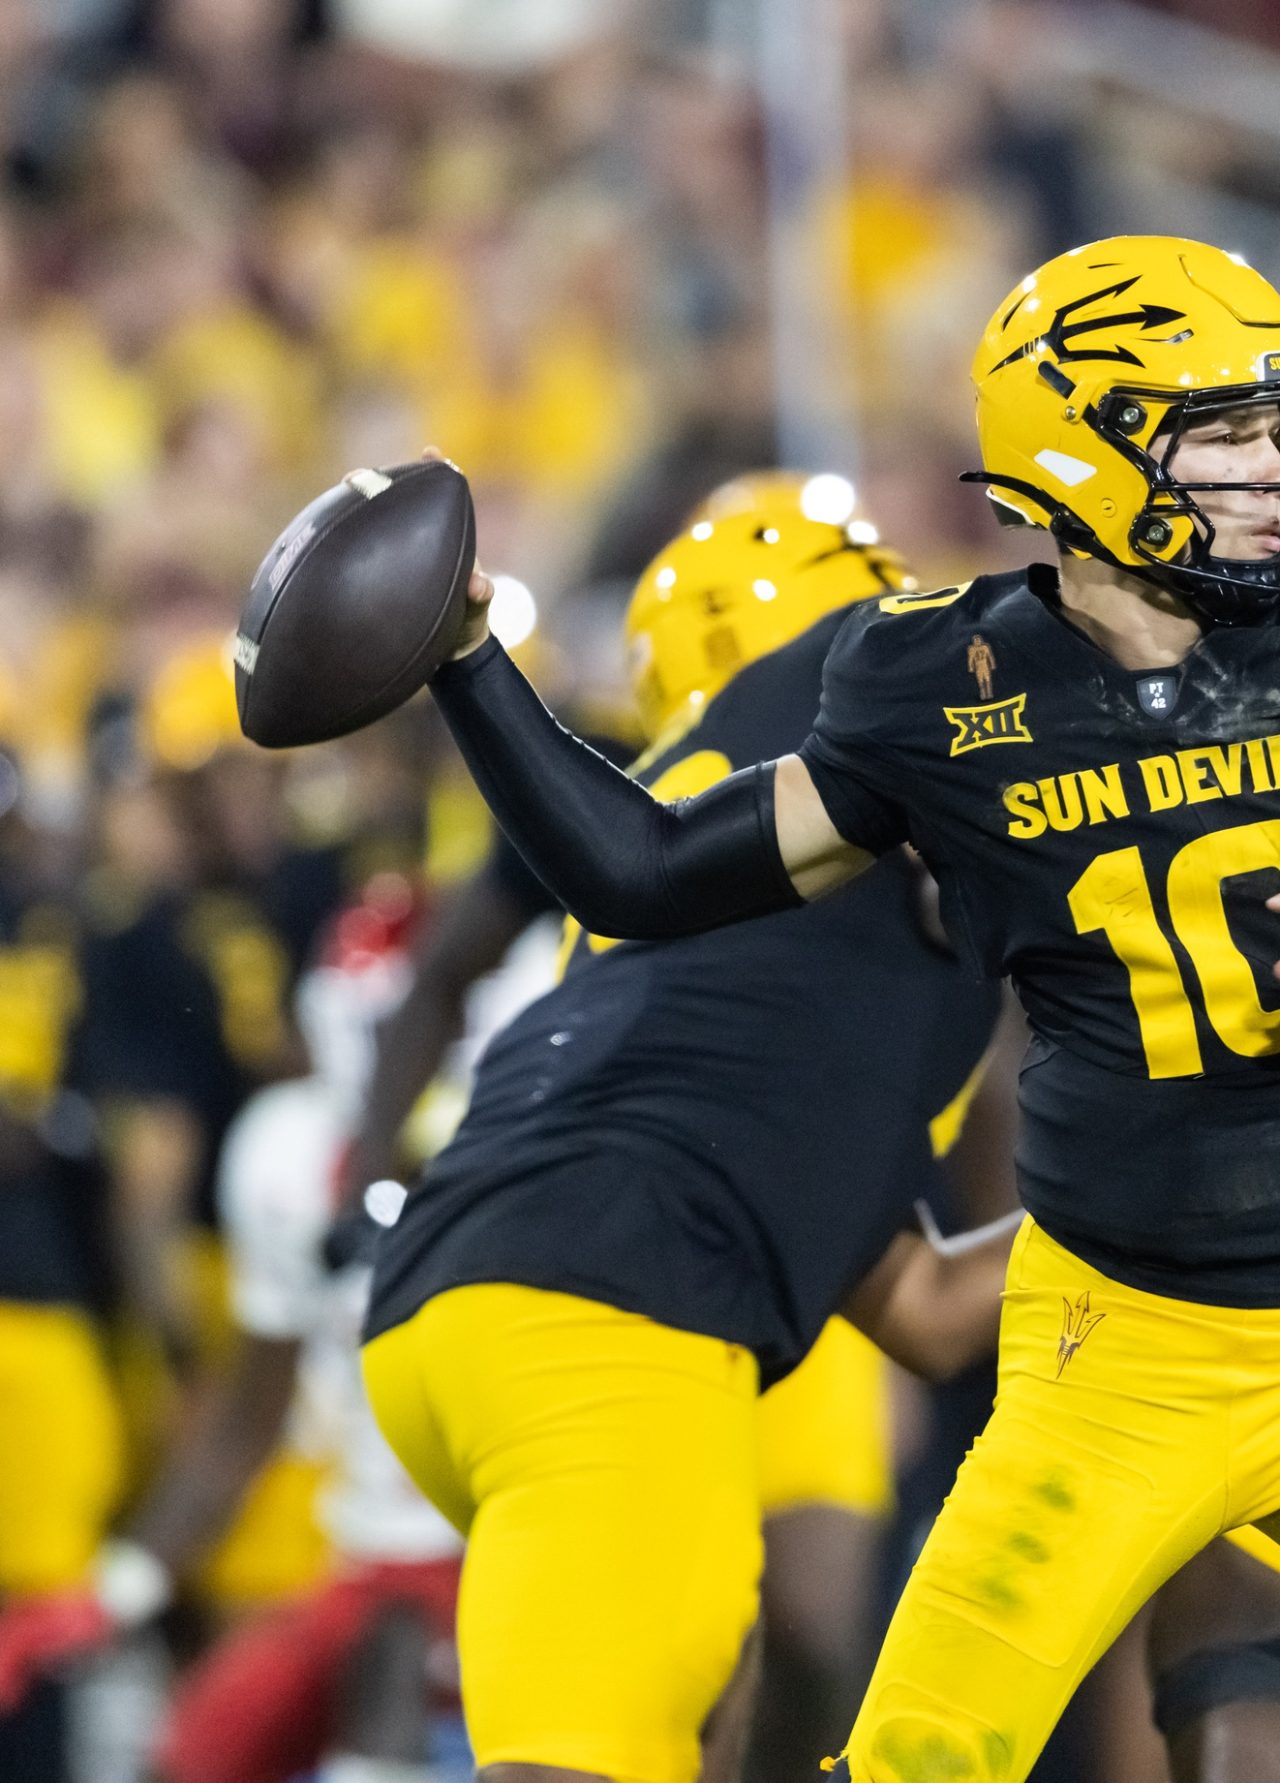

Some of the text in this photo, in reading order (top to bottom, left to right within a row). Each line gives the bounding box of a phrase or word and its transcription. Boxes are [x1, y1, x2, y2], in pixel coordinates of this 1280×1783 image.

[1149, 682, 1164, 694] PT
[1151, 697, 1167, 709] 42
[952, 700, 1026, 750] XII
[1002, 763, 1129, 840] SUN
